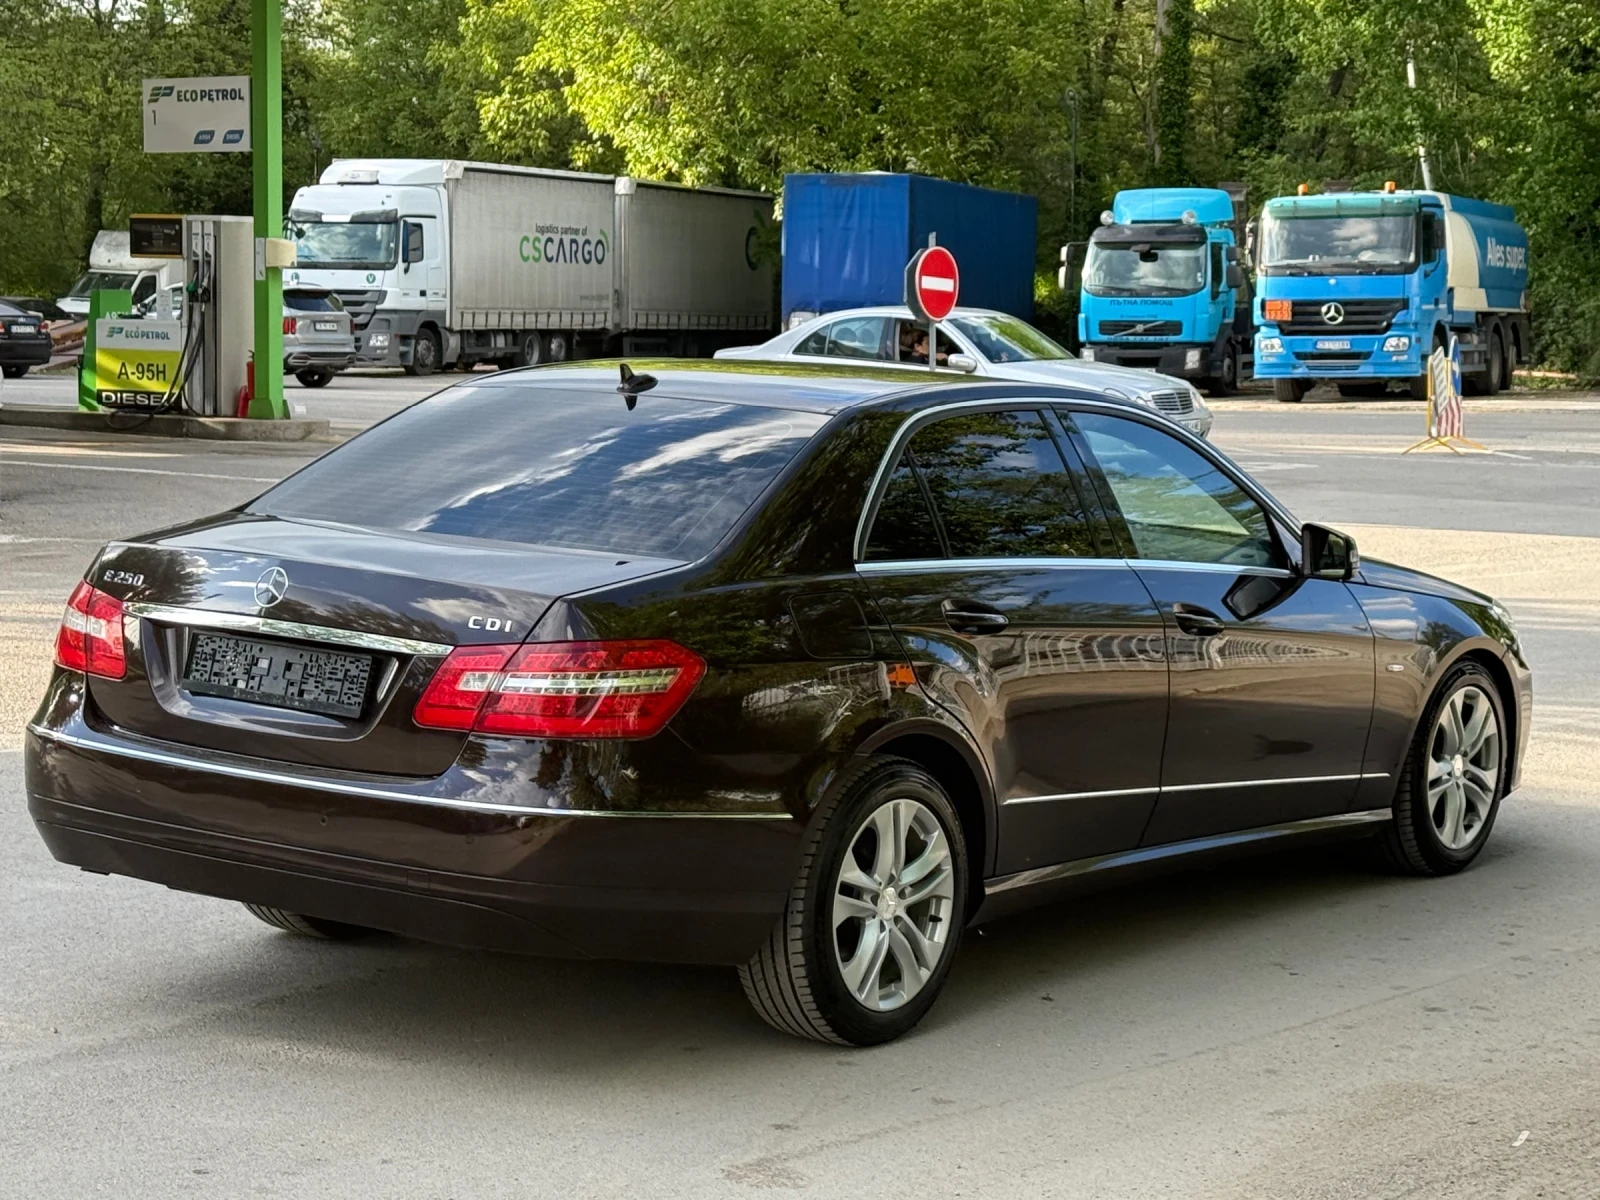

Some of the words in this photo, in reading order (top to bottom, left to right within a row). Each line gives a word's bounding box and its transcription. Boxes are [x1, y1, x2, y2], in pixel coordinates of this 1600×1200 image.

[176, 88, 245, 103] ECOPETROL
[152, 109, 157, 126] 1
[535, 223, 559, 236] logistics
[560, 226, 580, 237] partner
[581, 226, 588, 237] of
[1486, 236, 1505, 268] Alles
[125, 329, 171, 341] ECOPETROL
[117, 361, 167, 382] A-95H
[468, 615, 512, 633] CDI
